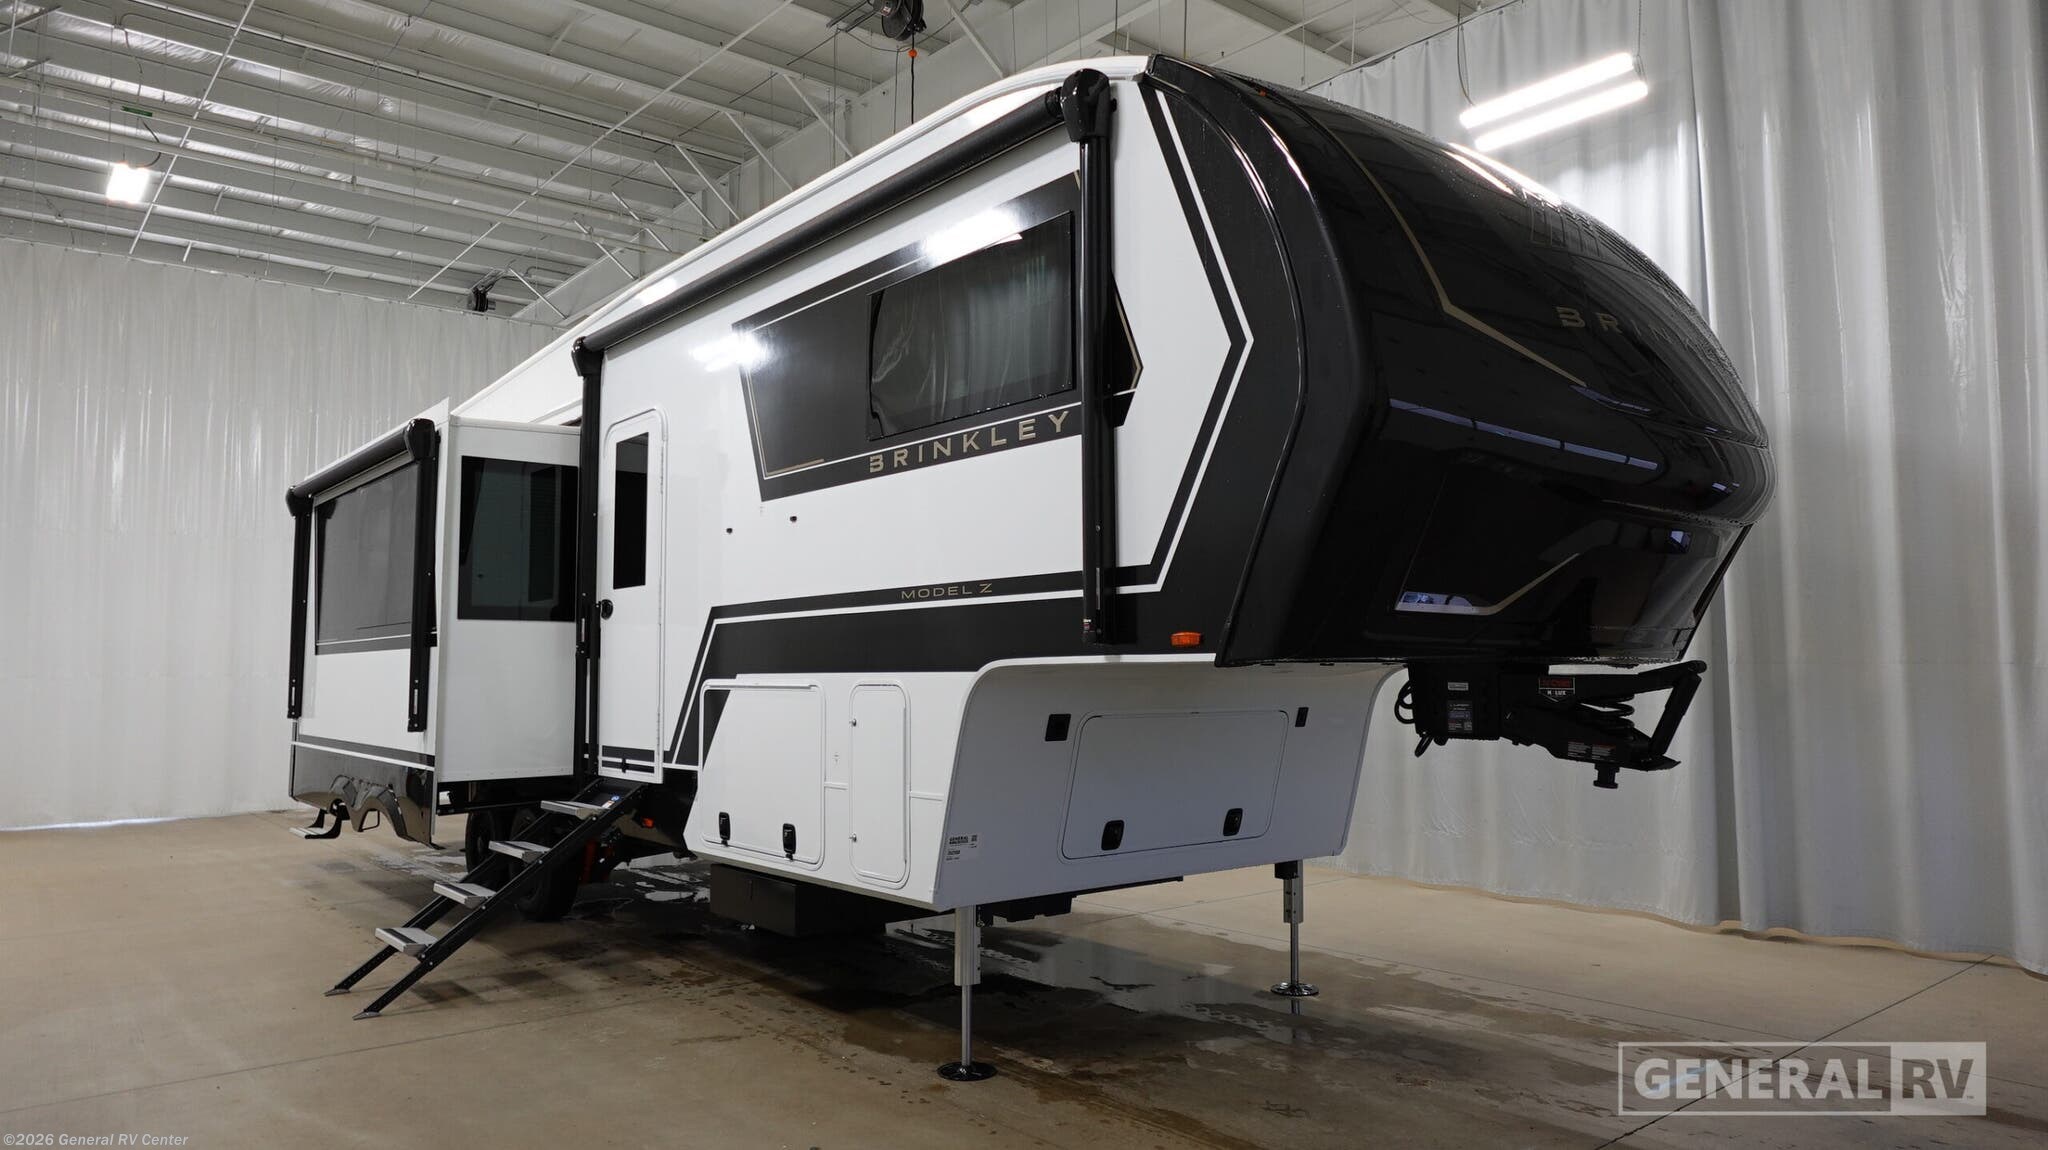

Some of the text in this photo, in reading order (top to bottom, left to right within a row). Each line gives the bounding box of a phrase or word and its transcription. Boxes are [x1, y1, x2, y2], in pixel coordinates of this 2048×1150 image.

[869, 410, 1069, 473] BRINKLEY
[901, 582, 993, 600] MODEL Z
